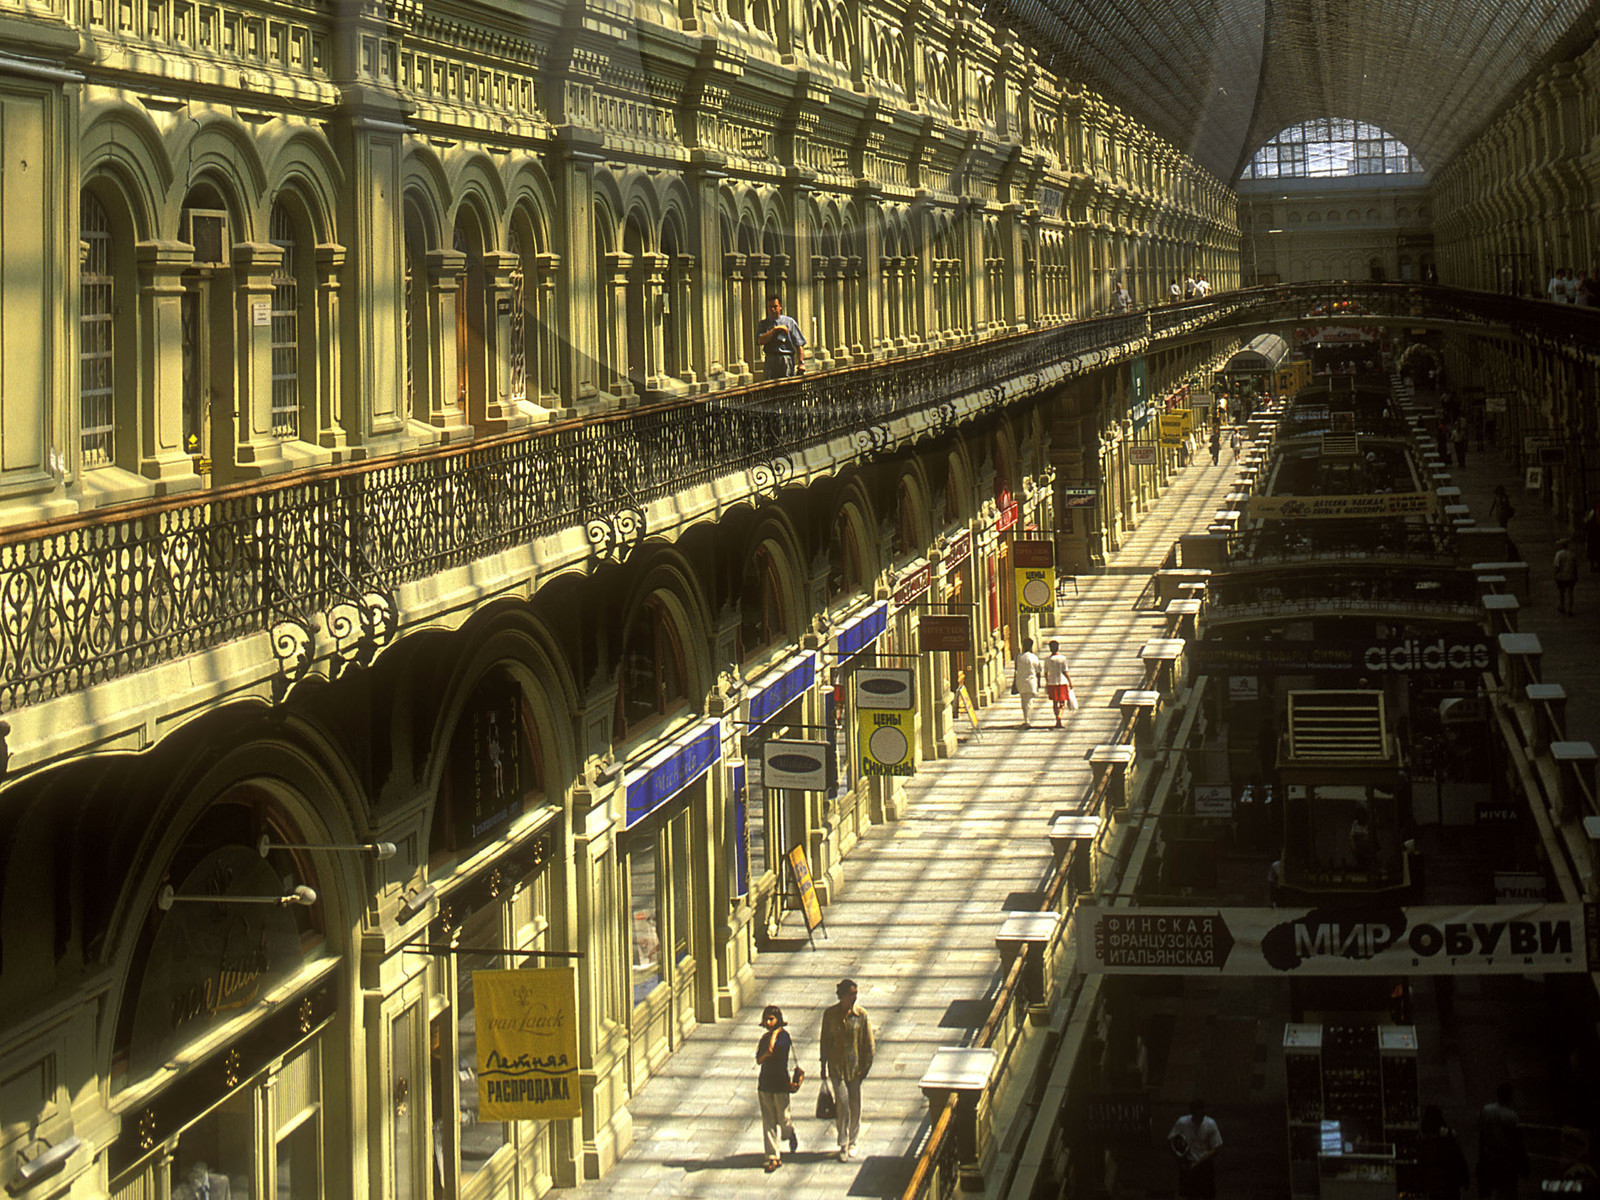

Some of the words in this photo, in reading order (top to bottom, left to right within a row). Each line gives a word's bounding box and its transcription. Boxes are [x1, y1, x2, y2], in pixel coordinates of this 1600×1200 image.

[1025, 571, 1046, 580] ЦЕНЫ
[1363, 638, 1489, 671] adidas
[873, 713, 902, 728] ЦЕНЫ
[862, 756, 915, 777] СНИЖЕНЫ
[1108, 918, 1213, 933] ФИНСКАЯ
[1109, 934, 1214, 951] ФРАНЦУЗСКАЯ
[1293, 922, 1392, 958] МИР
[1408, 919, 1574, 957] ОБУВИ
[1109, 949, 1214, 966] ИТАЛЬЯНСКАЯ
[486, 1049, 569, 1069] Летняя
[487, 1078, 571, 1104] РАСПРОДАЖА
